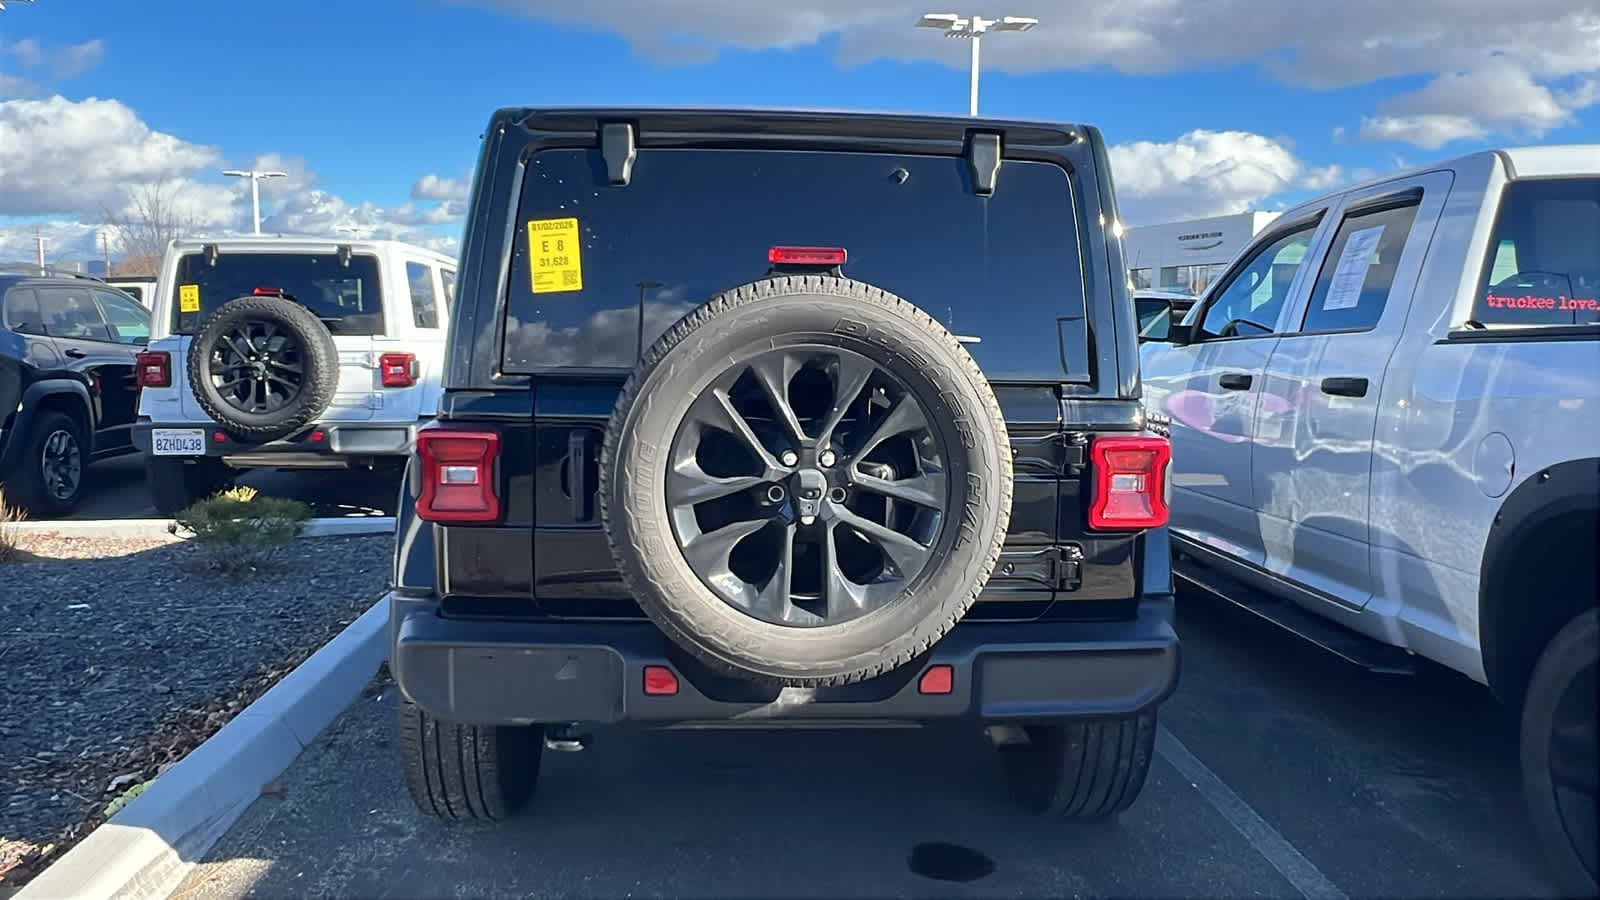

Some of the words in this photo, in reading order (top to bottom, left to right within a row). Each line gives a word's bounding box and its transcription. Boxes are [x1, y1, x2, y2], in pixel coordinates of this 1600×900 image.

[542, 241, 550, 253] E
[557, 240, 564, 251] 8
[1486, 294, 1556, 310] truckee
[156, 438, 202, 451] 8ZHD438
